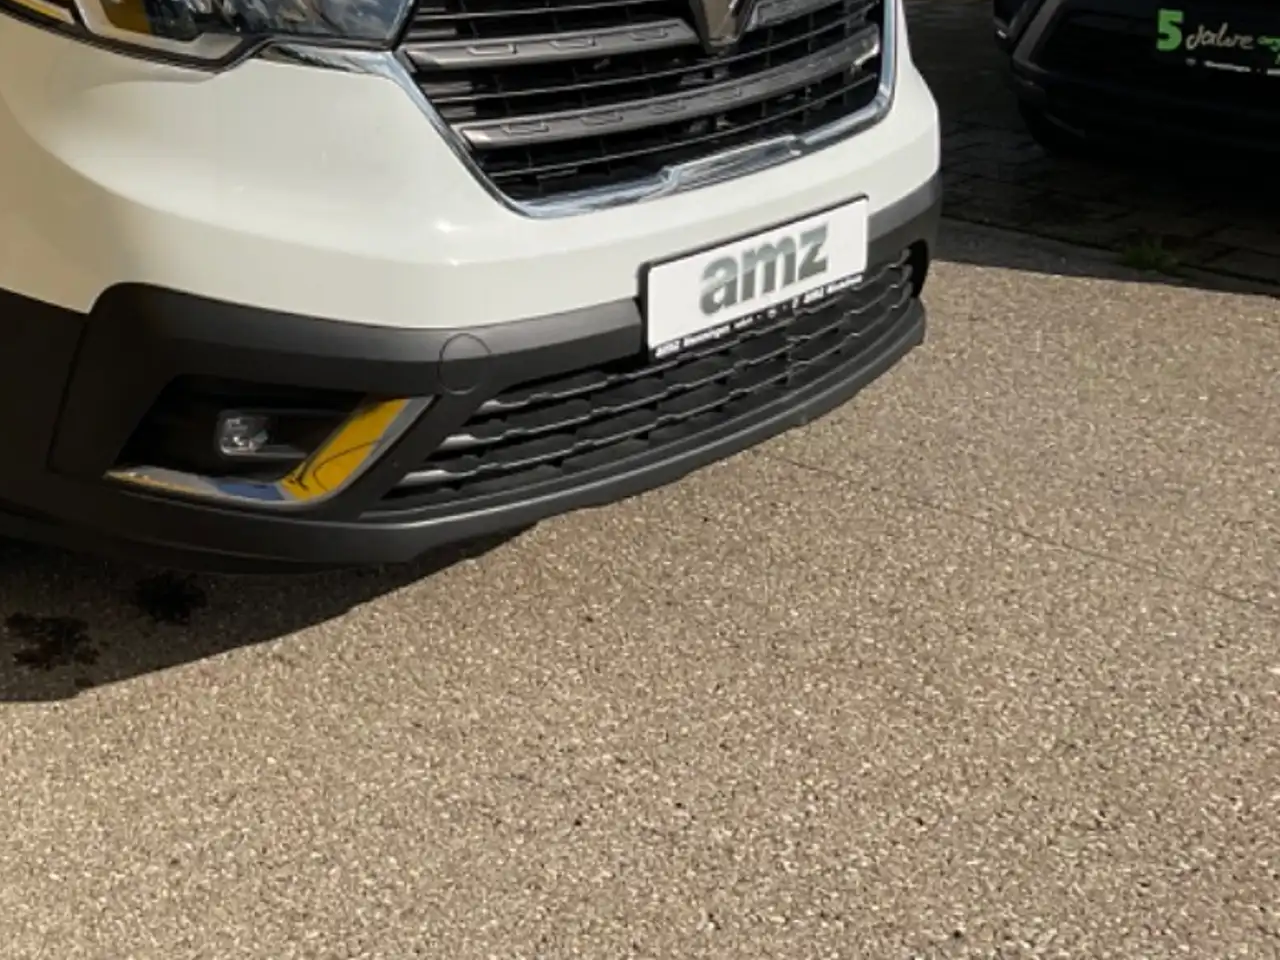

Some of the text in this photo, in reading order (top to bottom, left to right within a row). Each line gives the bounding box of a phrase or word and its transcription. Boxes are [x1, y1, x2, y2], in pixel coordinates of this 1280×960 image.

[1157, 9, 1183, 51] 5
[1186, 22, 1254, 50] Jahre
[701, 224, 827, 315] amz
